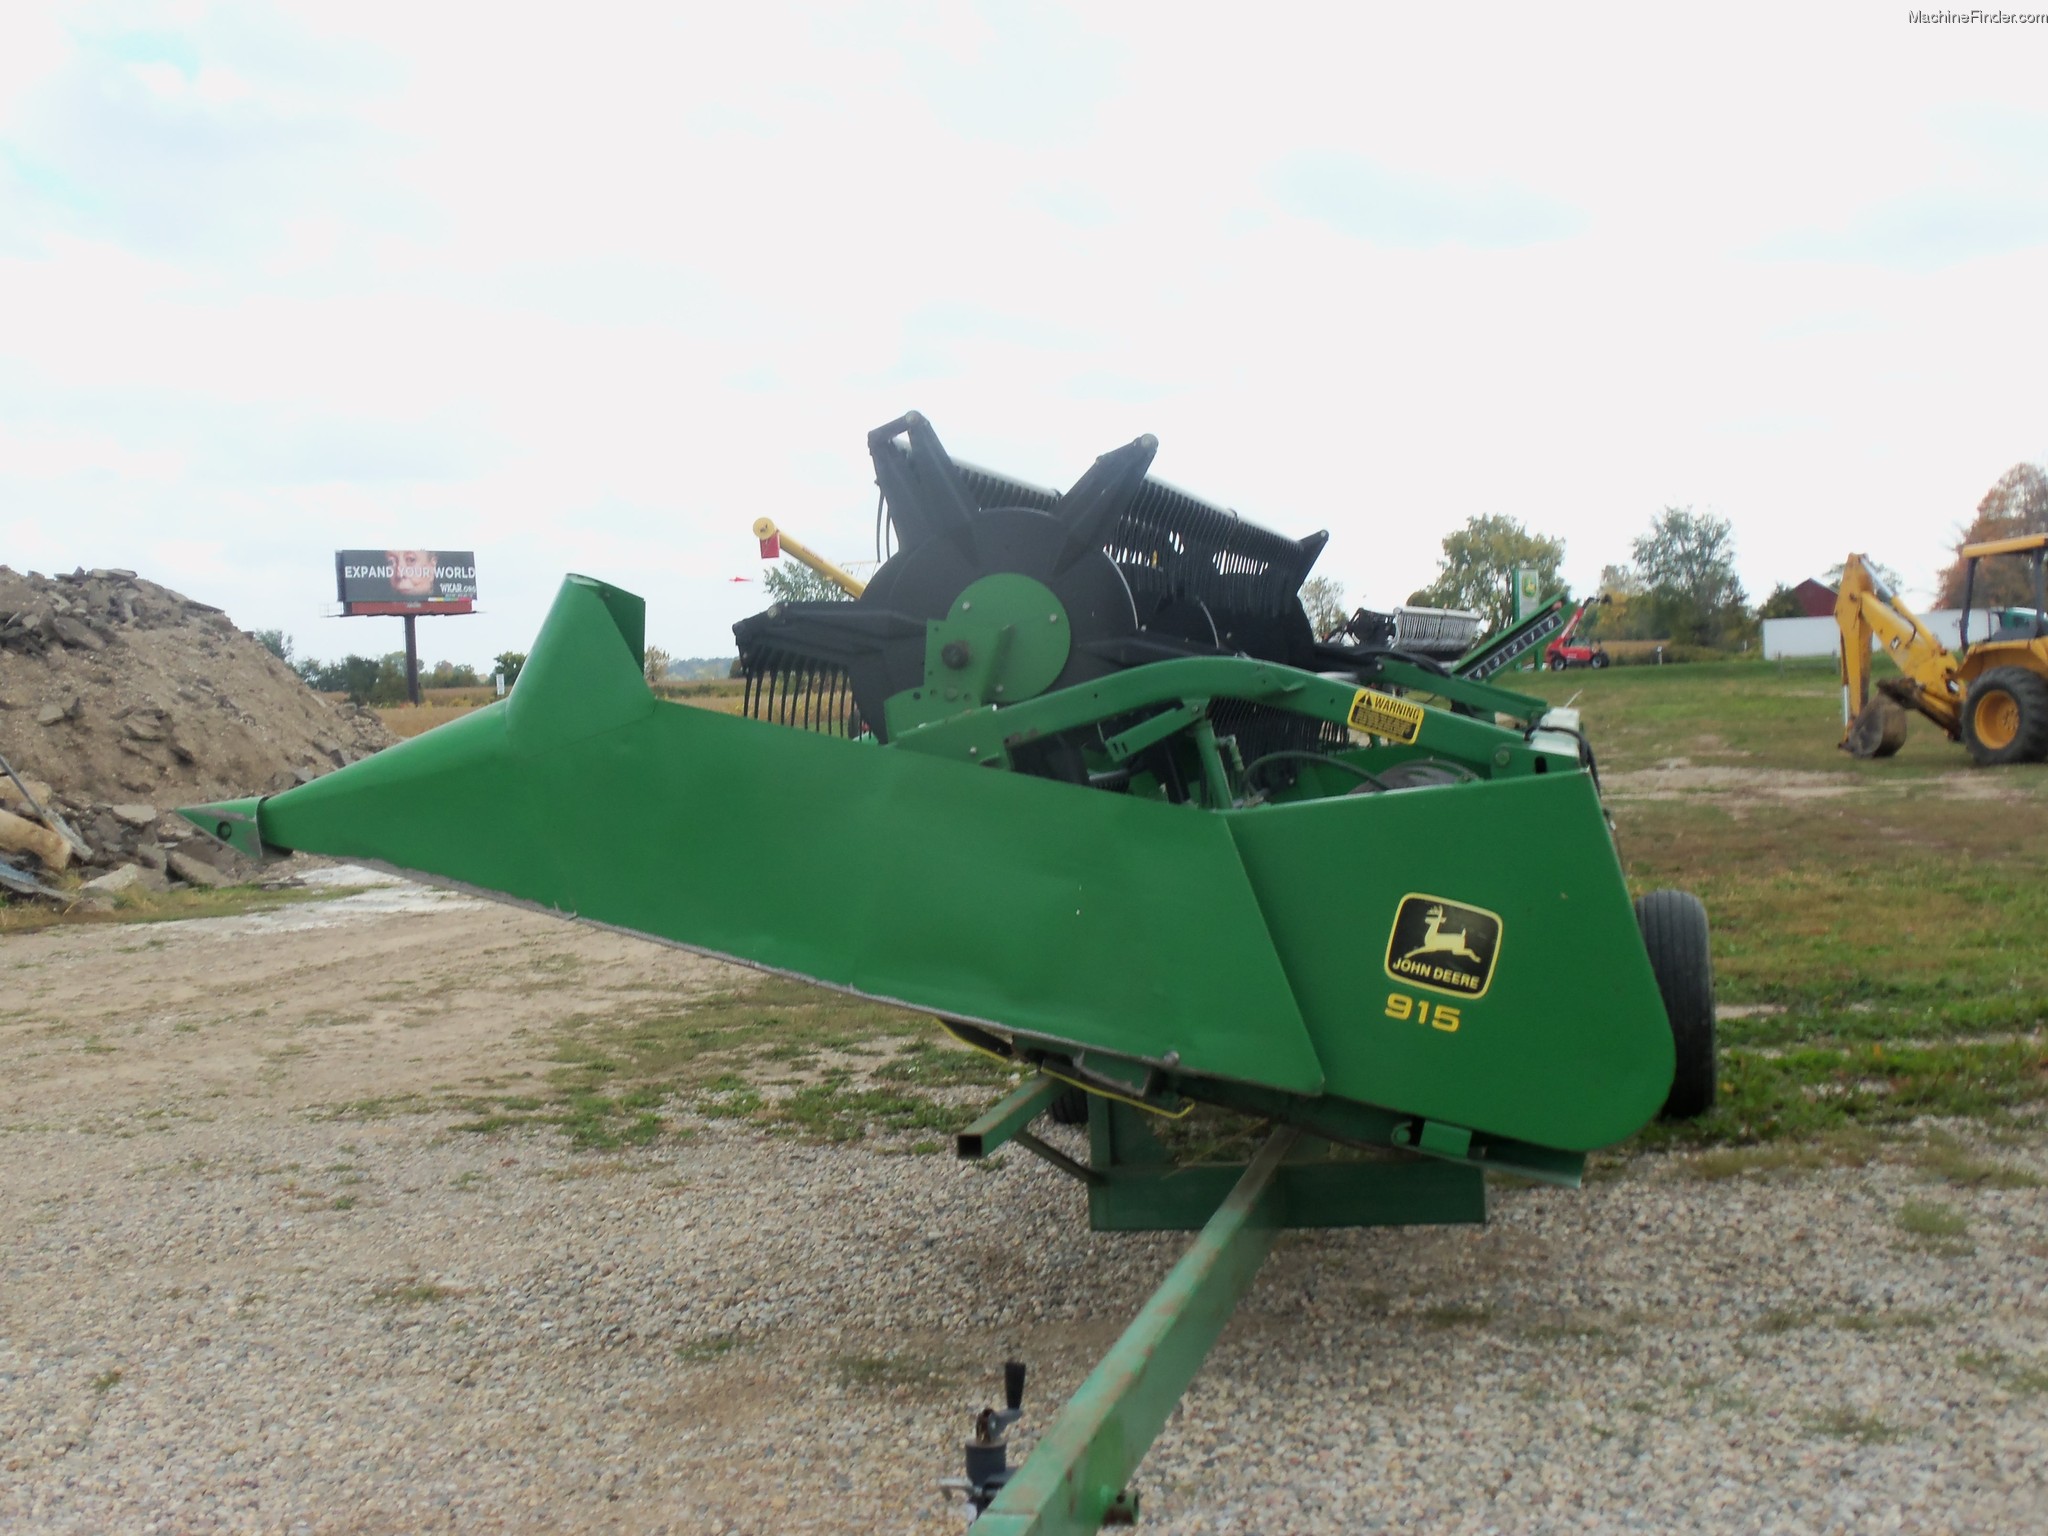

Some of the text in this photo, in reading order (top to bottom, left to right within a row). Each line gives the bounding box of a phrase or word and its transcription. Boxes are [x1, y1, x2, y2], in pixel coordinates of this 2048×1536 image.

[344, 566, 477, 578] EXPAND YOUR WORLD
[1374, 695, 1420, 720] WARNING
[1392, 957, 1480, 989] JOHN DEERE
[1385, 993, 1461, 1032] 915
